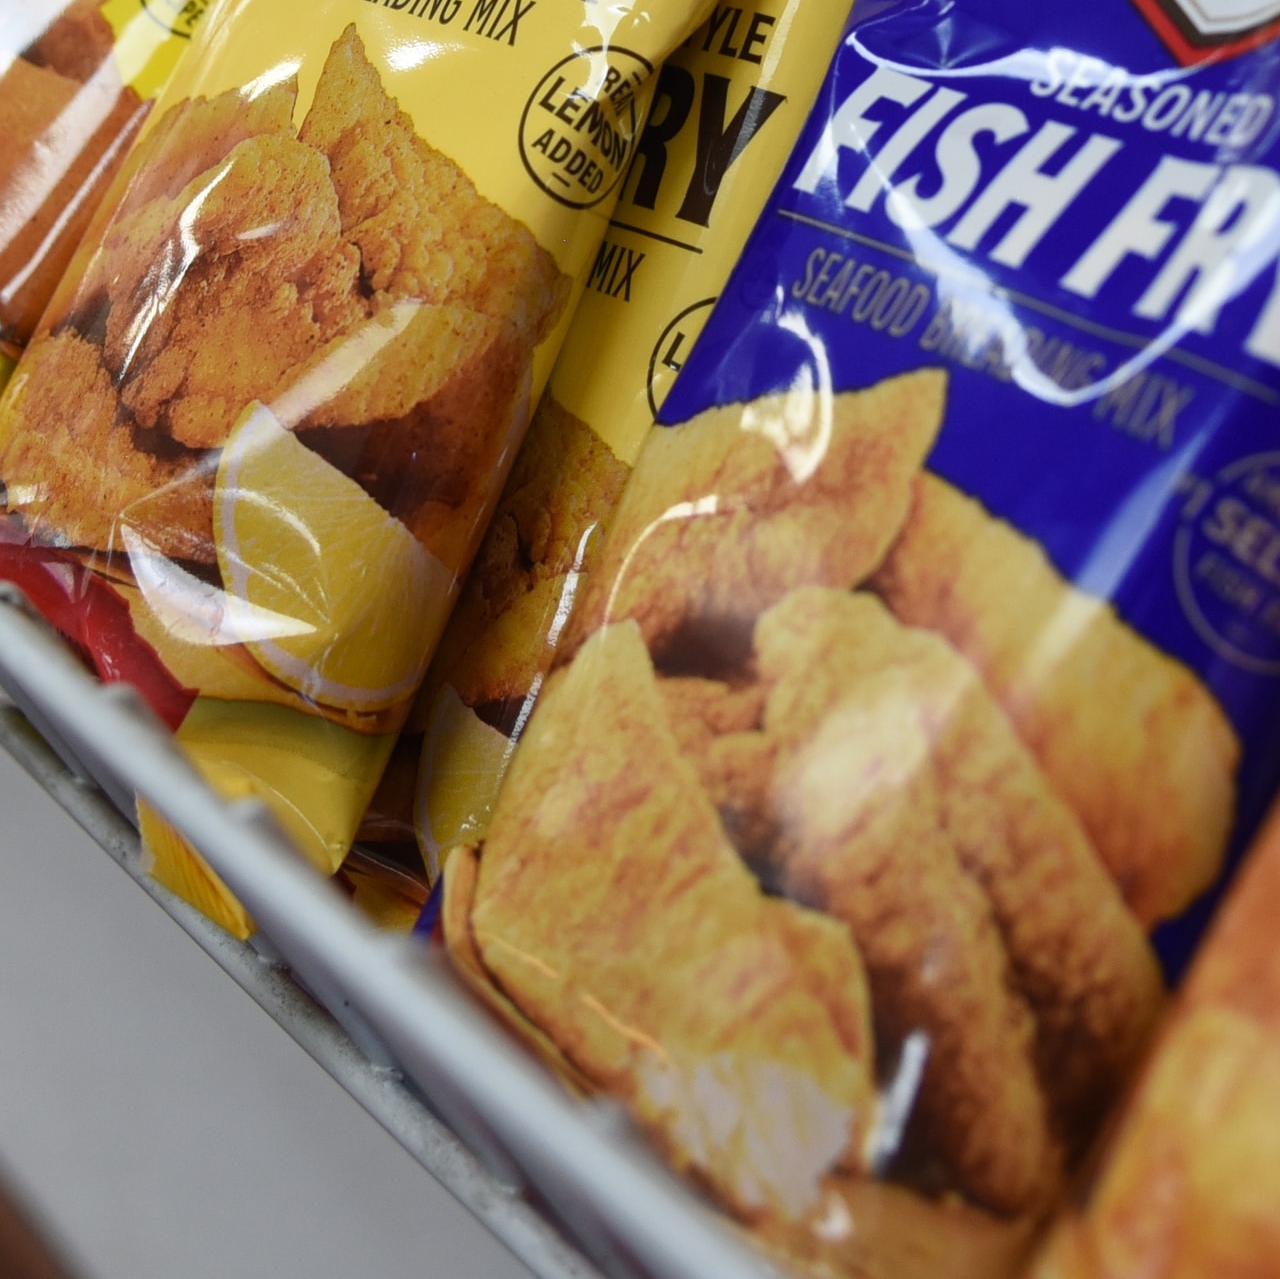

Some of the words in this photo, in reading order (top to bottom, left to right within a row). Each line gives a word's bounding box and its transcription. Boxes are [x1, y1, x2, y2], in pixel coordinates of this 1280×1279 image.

[1029, 47, 1276, 148] SEASONED
[532, 128, 605, 195] ADDED
[792, 65, 1125, 270] FISH
[586, 240, 646, 303] MIX
[792, 247, 931, 337] SEAFOOD
[1092, 366, 1194, 450] MIX
